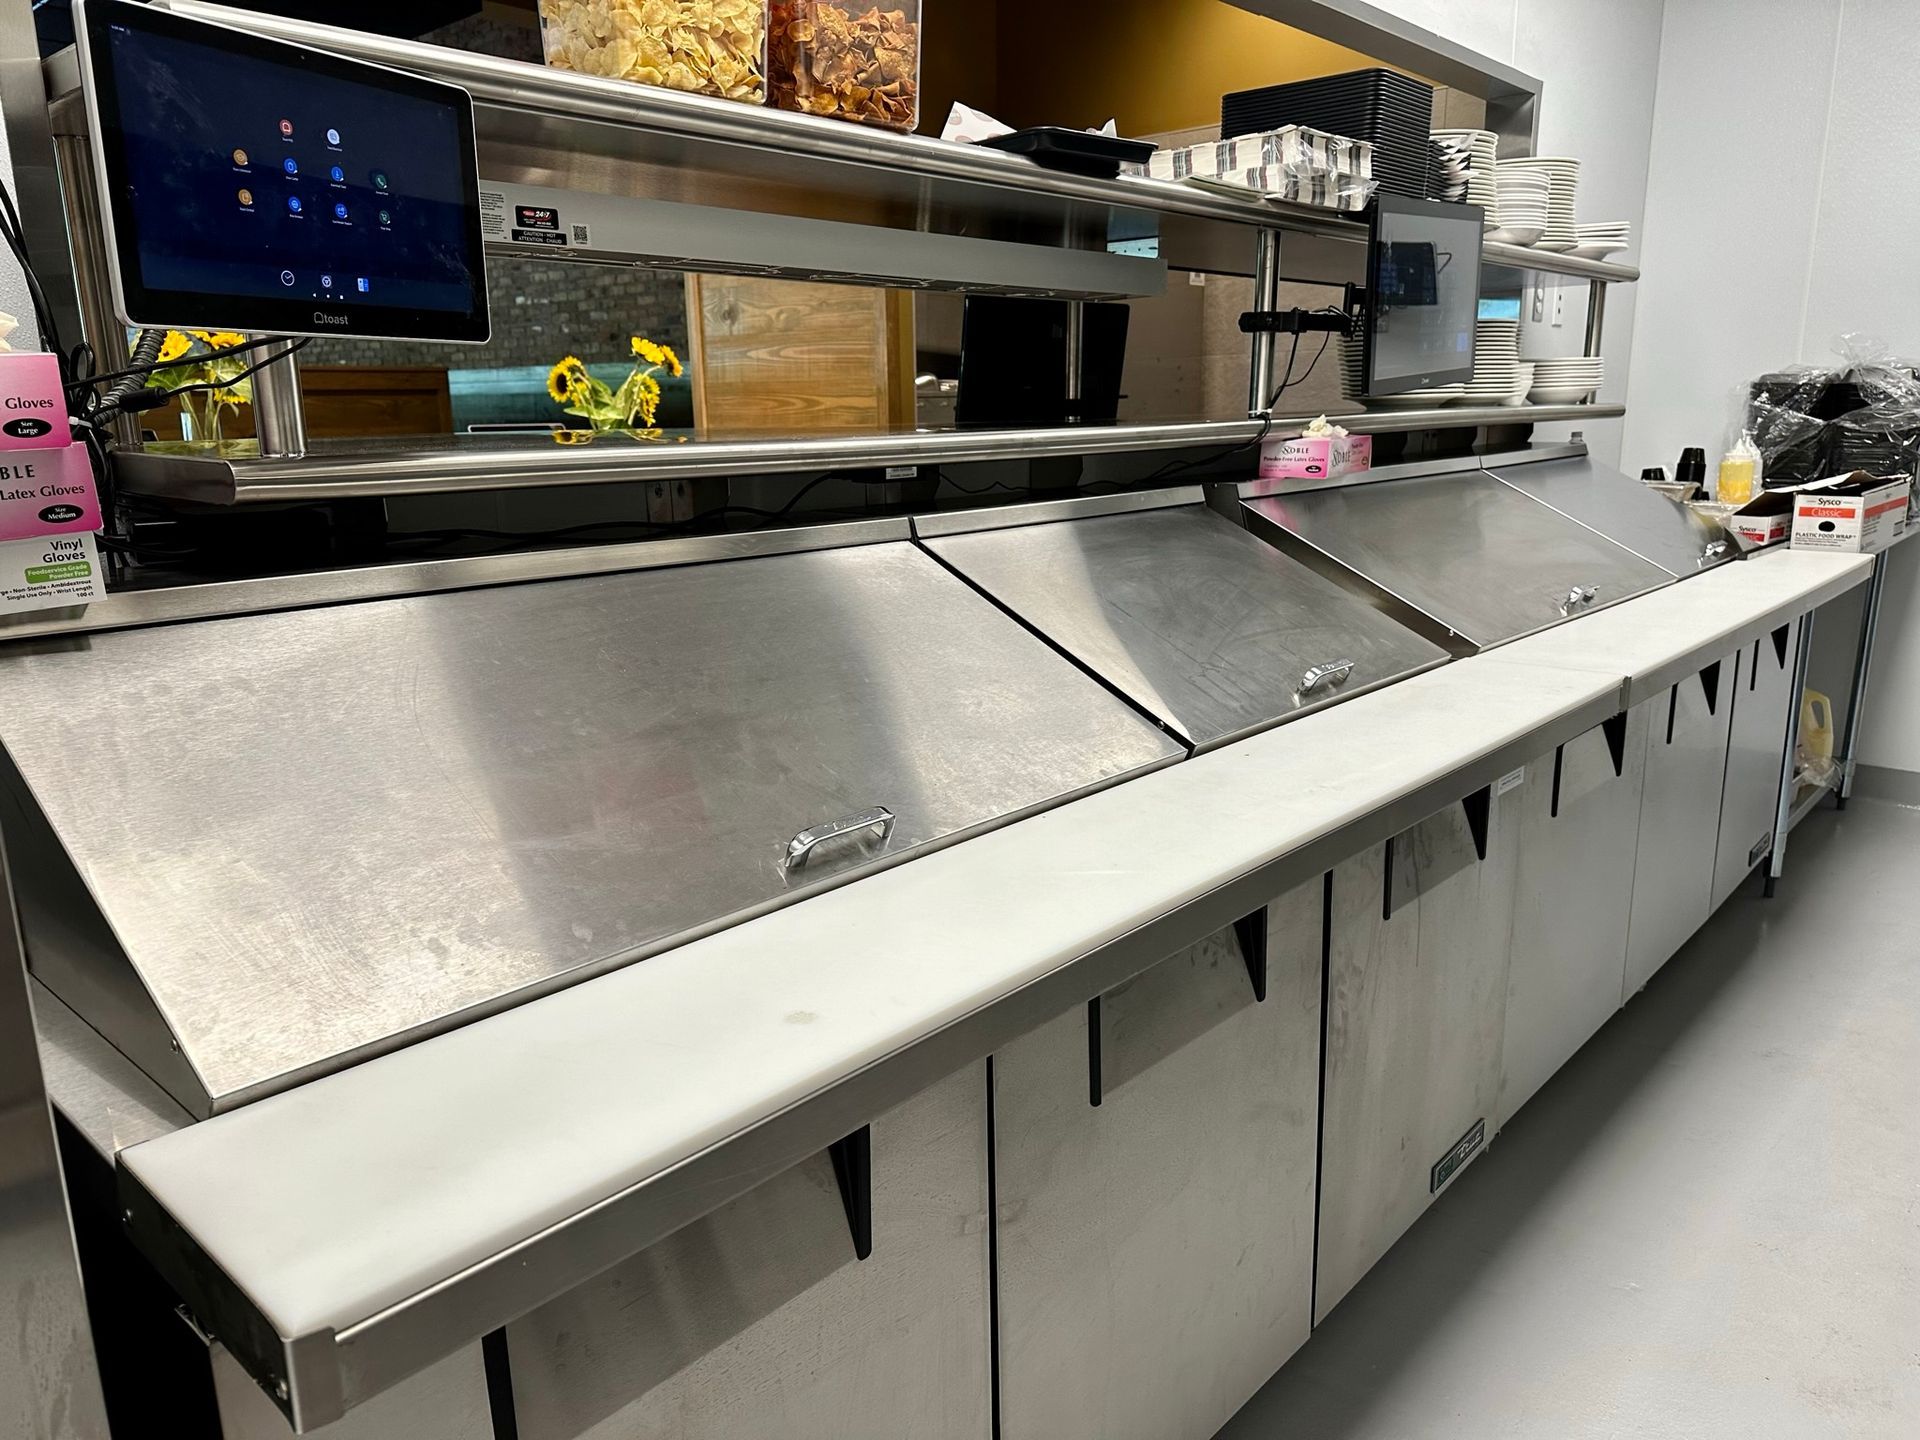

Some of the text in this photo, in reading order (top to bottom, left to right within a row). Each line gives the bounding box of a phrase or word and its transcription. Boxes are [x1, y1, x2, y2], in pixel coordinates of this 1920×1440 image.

[324, 314, 349, 325] toast
[4, 396, 54, 410] Gloves
[17, 428, 39, 436] Large
[1281, 446, 1310, 455] NOBLE
[0, 464, 36, 480] BLE
[0, 484, 86, 501] Latex Gloves
[1818, 497, 1841, 506] Sysco
[47, 512, 77, 520] Medium
[1811, 508, 1842, 517] Classic
[50, 538, 83, 551] Vinyl
[42, 551, 86, 563] Gloves
[27, 567, 67, 576] Foodservice
[50, 579, 92, 589] Ambidextrous
[7, 593, 26, 601] Single
[38, 590, 53, 598] Only
[72, 585, 93, 593] Length
